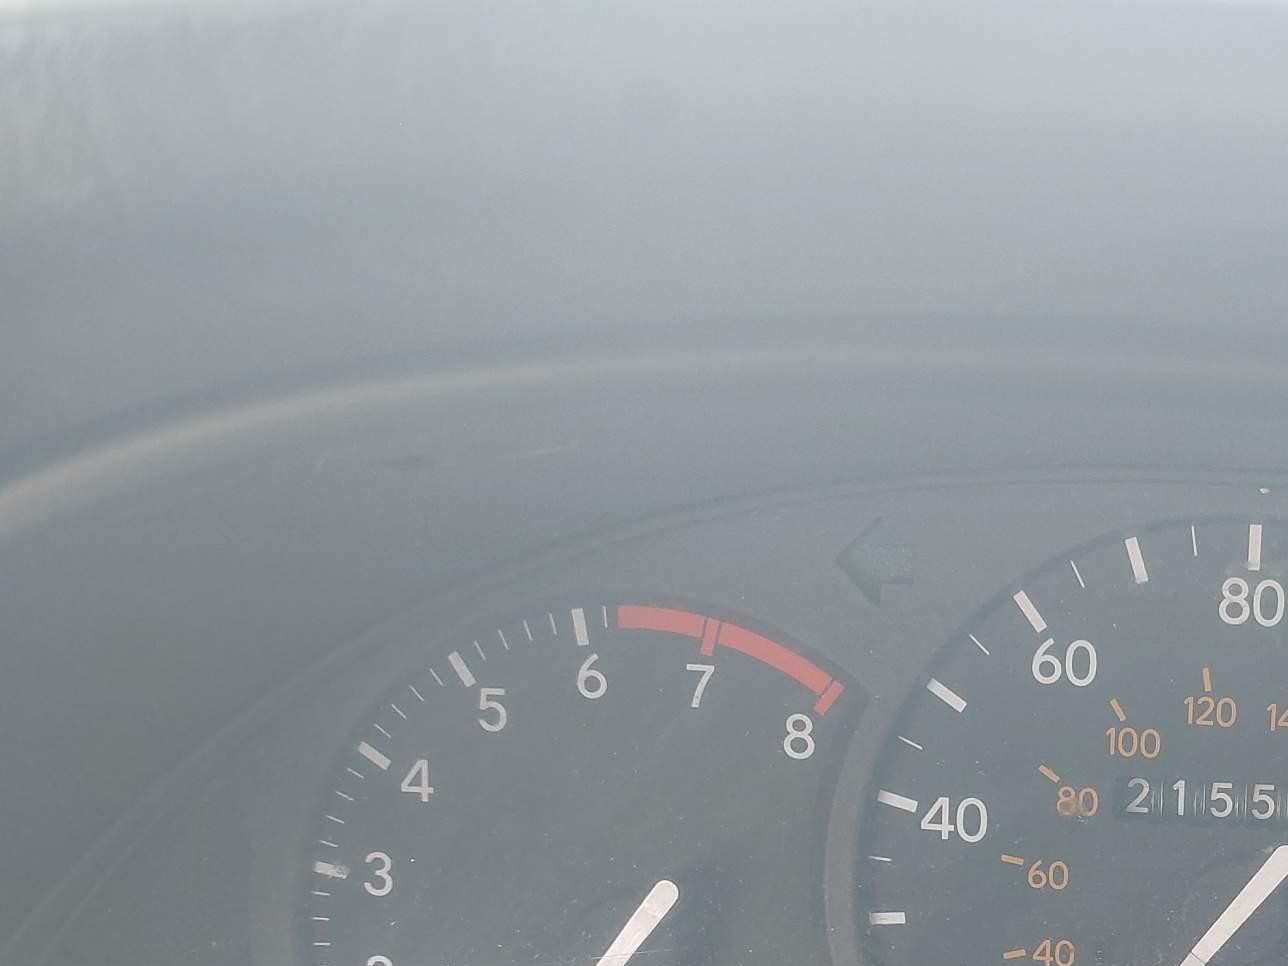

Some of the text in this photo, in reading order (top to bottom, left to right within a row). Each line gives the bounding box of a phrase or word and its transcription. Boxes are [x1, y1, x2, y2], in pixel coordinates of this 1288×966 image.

[1218, 577, 1285, 627] 80
[577, 654, 607, 698] 6
[1032, 638, 1097, 686] 60
[686, 664, 715, 708] 7
[478, 688, 506, 732] 5
[1184, 697, 1237, 727] 120
[783, 714, 815, 759] 8
[1105, 728, 1160, 758] 100
[401, 760, 434, 802] 4
[1056, 786, 1098, 816] 80
[920, 797, 988, 842] 40
[363, 852, 394, 896] 3
[1027, 860, 1069, 890] 60
